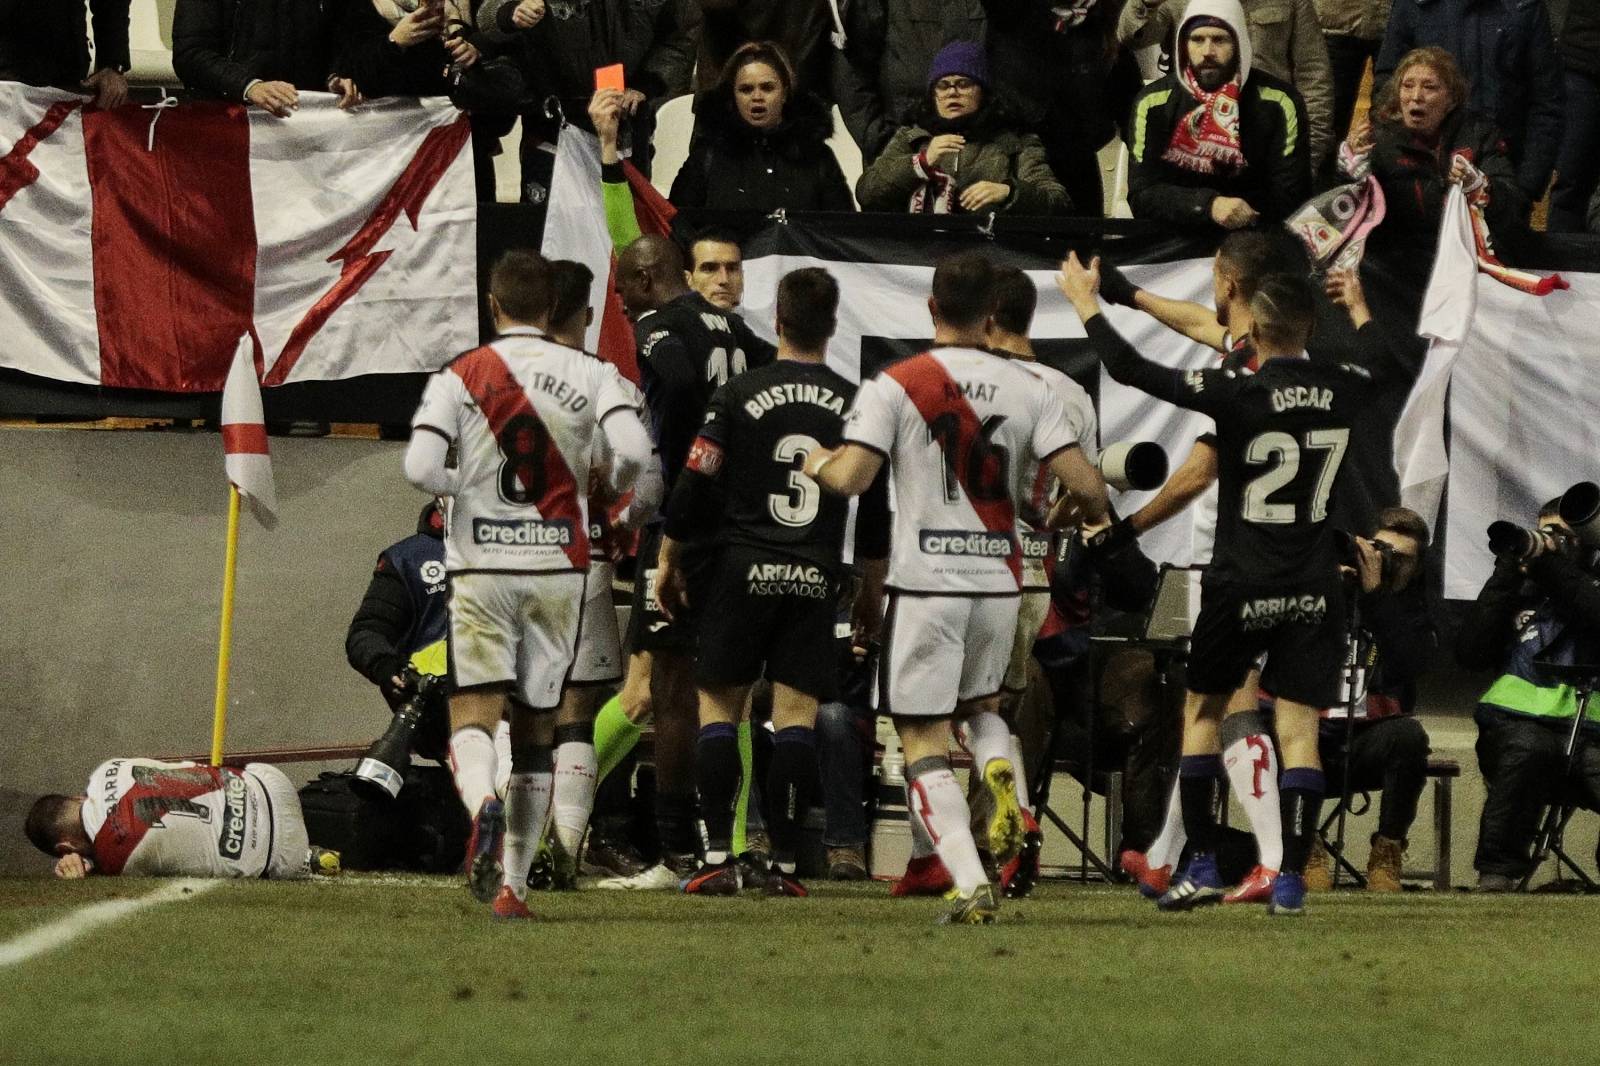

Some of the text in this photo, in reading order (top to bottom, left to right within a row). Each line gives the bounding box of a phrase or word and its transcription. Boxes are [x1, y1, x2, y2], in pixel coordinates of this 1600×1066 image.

[533, 371, 588, 413] TREJO
[744, 383, 845, 420] BUSTINZA
[944, 380, 999, 402] AMAT
[1272, 386, 1333, 413] ÓSCAR
[496, 412, 552, 507] 8
[927, 411, 1010, 506] 16
[1242, 428, 1351, 523] 27
[769, 433, 821, 527] 3
[478, 522, 570, 545] creditea
[925, 533, 1011, 556] creditea
[1241, 595, 1327, 619] ARRIAGA
[226, 778, 247, 854] credite
